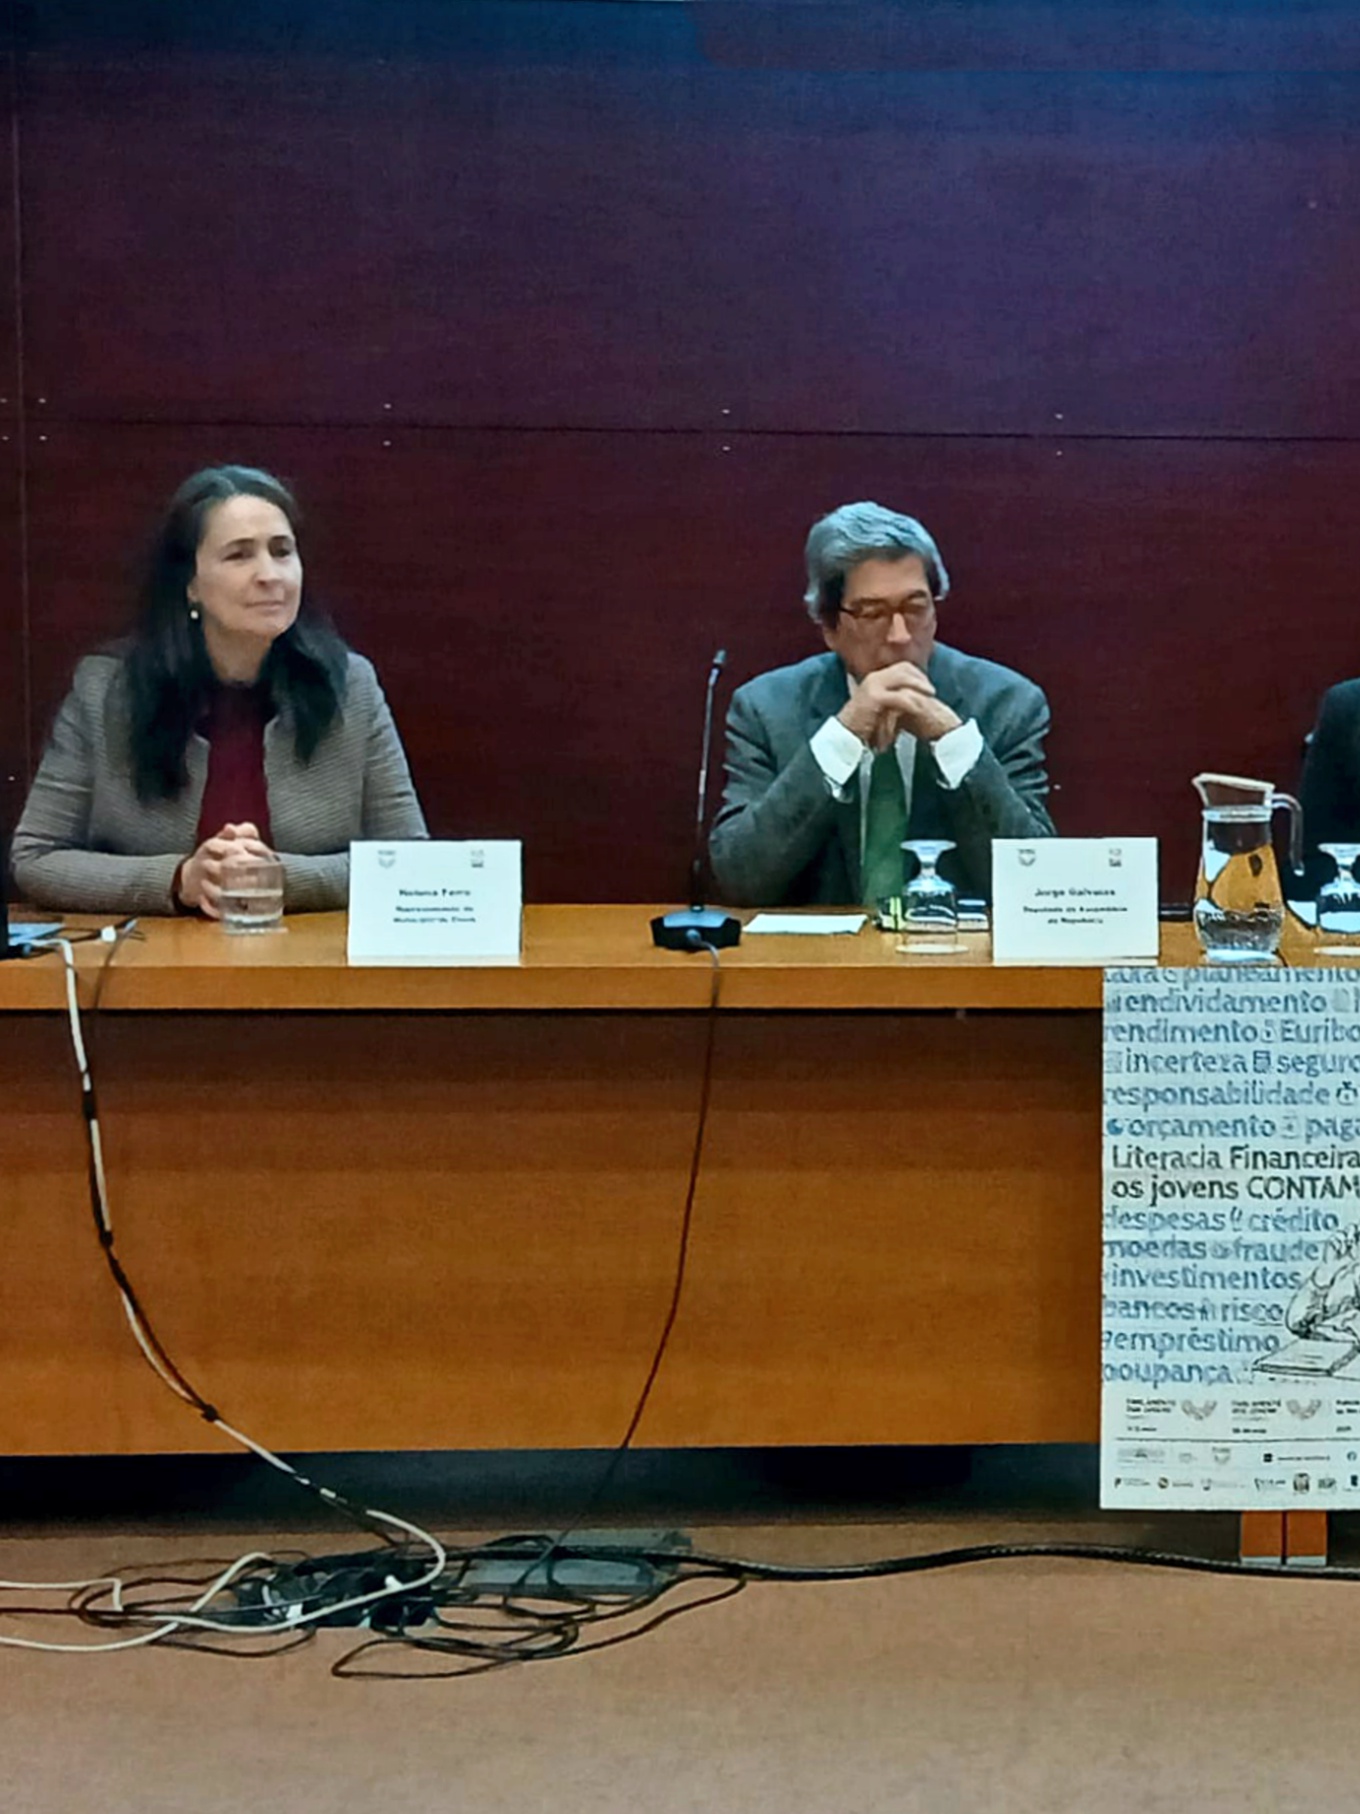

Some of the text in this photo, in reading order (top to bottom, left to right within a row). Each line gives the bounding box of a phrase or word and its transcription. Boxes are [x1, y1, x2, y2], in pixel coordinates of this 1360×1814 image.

[1125, 987, 1327, 1013] endividamento
[1126, 1047, 1248, 1073] incerteza
[1104, 1080, 1330, 1112] responsabilidade
[1128, 1114, 1276, 1141] orçamento
[1113, 1145, 1223, 1169] Literacia
[1112, 1179, 1144, 1198] os
[1149, 1175, 1239, 1207] jovens
[1250, 1207, 1340, 1232] crédito
[1103, 1234, 1319, 1263] moedas fraude
[1112, 1263, 1301, 1290] investimentos
[1222, 1297, 1284, 1323] risco
[1114, 1327, 1280, 1359] empréstimo
